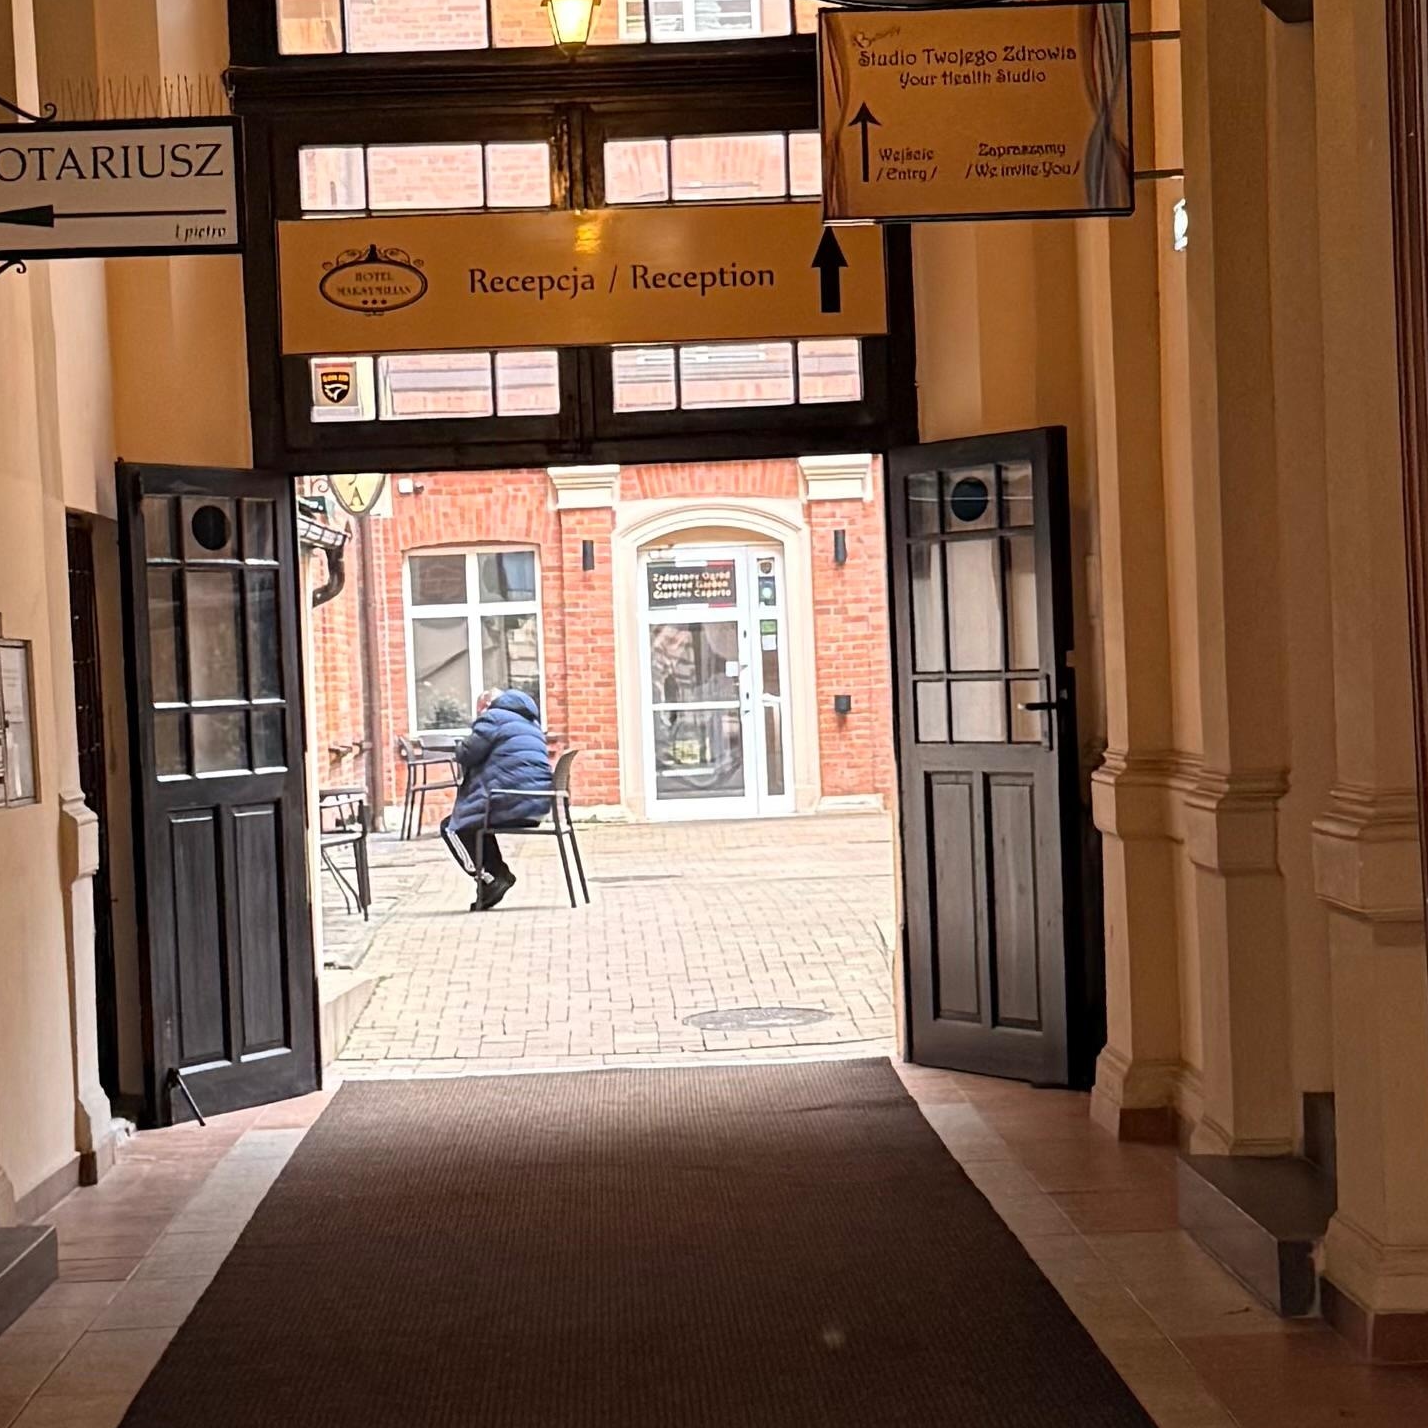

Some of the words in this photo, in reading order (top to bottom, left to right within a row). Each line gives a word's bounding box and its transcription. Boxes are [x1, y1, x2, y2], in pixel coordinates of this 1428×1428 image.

[858, 49, 917, 67] Studio
[922, 45, 998, 67] Twojego
[1002, 44, 1077, 63] Zdrowia
[899, 71, 938, 89] Your
[941, 70, 992, 86] Health
[995, 68, 1046, 83] Studio
[977, 143, 1067, 157] Zapraszamy
[1002, 162, 1039, 177] invite
[355, 272, 393, 282] HOTEL
[468, 266, 596, 300] Recepcja
[631, 262, 776, 296] Reception
[337, 286, 412, 296] MAKSYMILIAN
